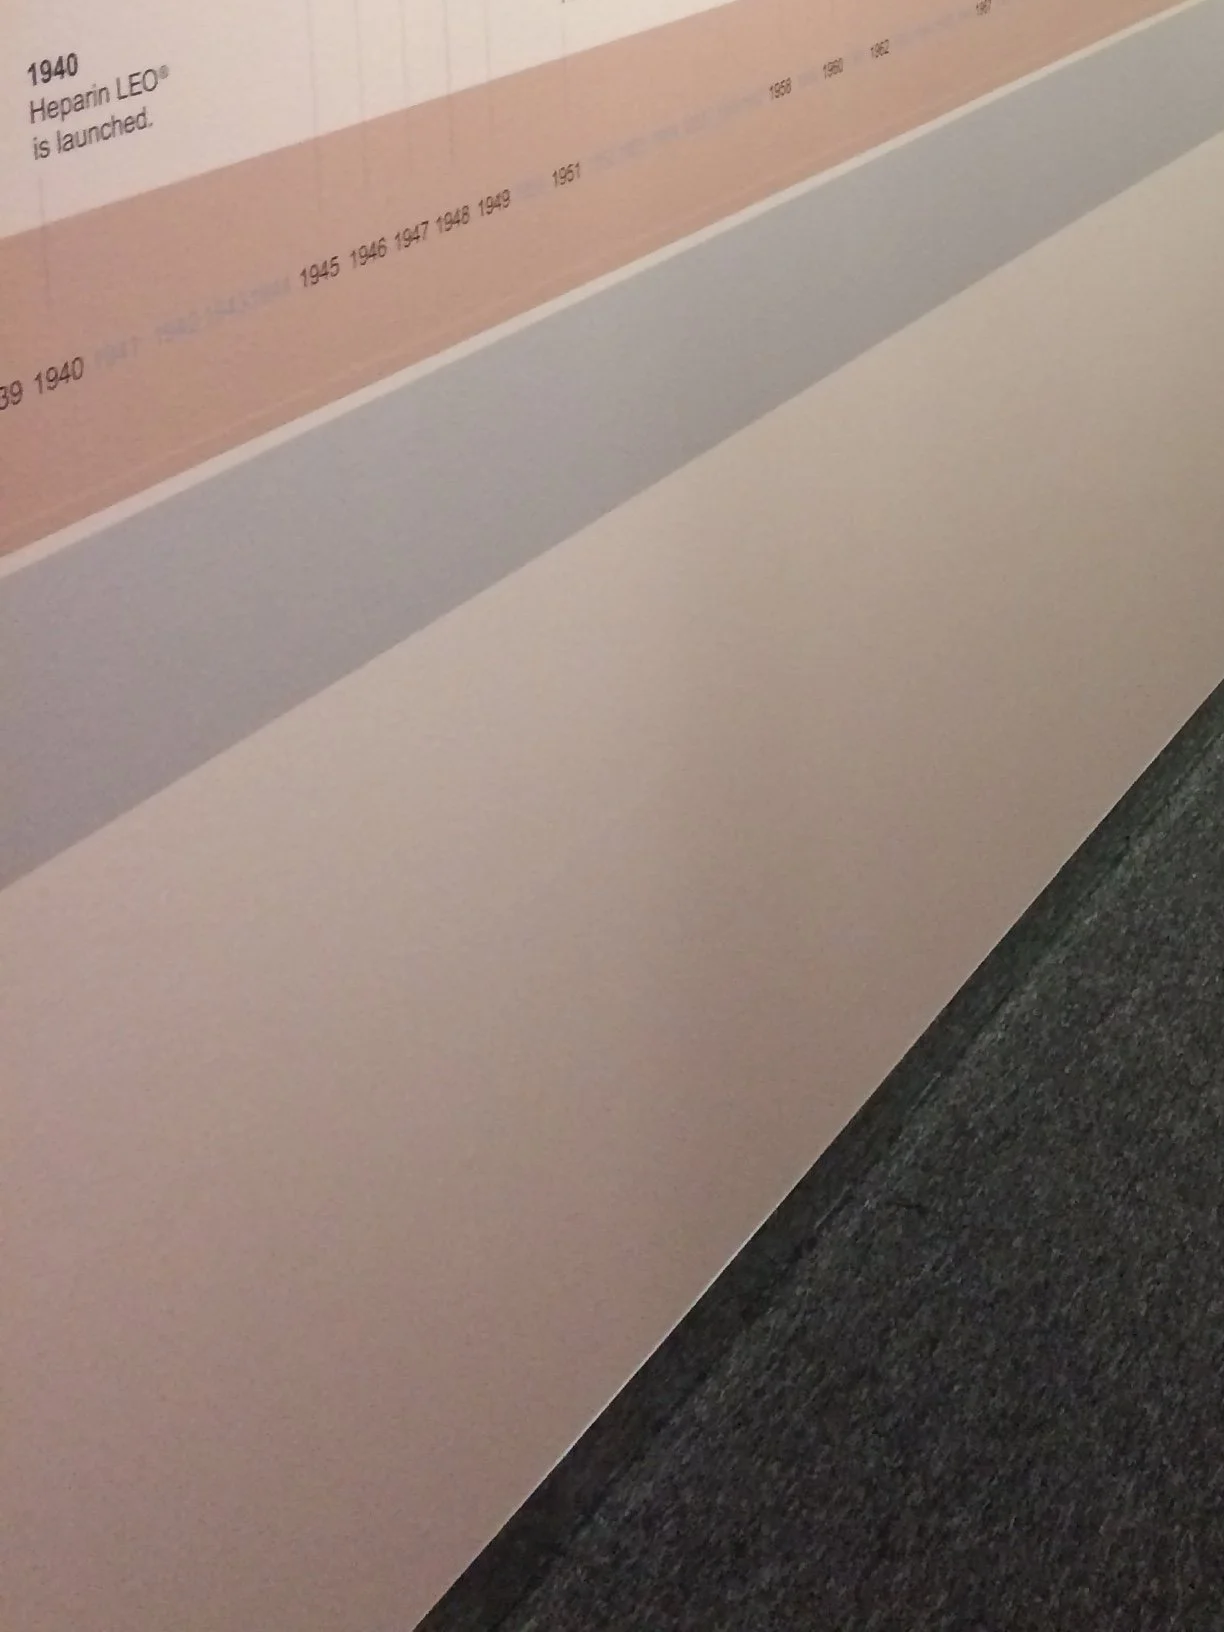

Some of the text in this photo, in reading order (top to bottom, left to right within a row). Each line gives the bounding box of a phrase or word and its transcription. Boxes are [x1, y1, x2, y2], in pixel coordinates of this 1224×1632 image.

[27, 52, 78, 86] 1940
[30, 84, 111, 124] Heparin
[33, 107, 153, 160] is launched.
[34, 356, 84, 396] 1940
[300, 256, 340, 288] 1945
[350, 238, 388, 269] 1946
[394, 220, 429, 252] 1947
[436, 204, 470, 235] 1948
[478, 189, 510, 219] 1949
[552, 162, 582, 189] 1951
